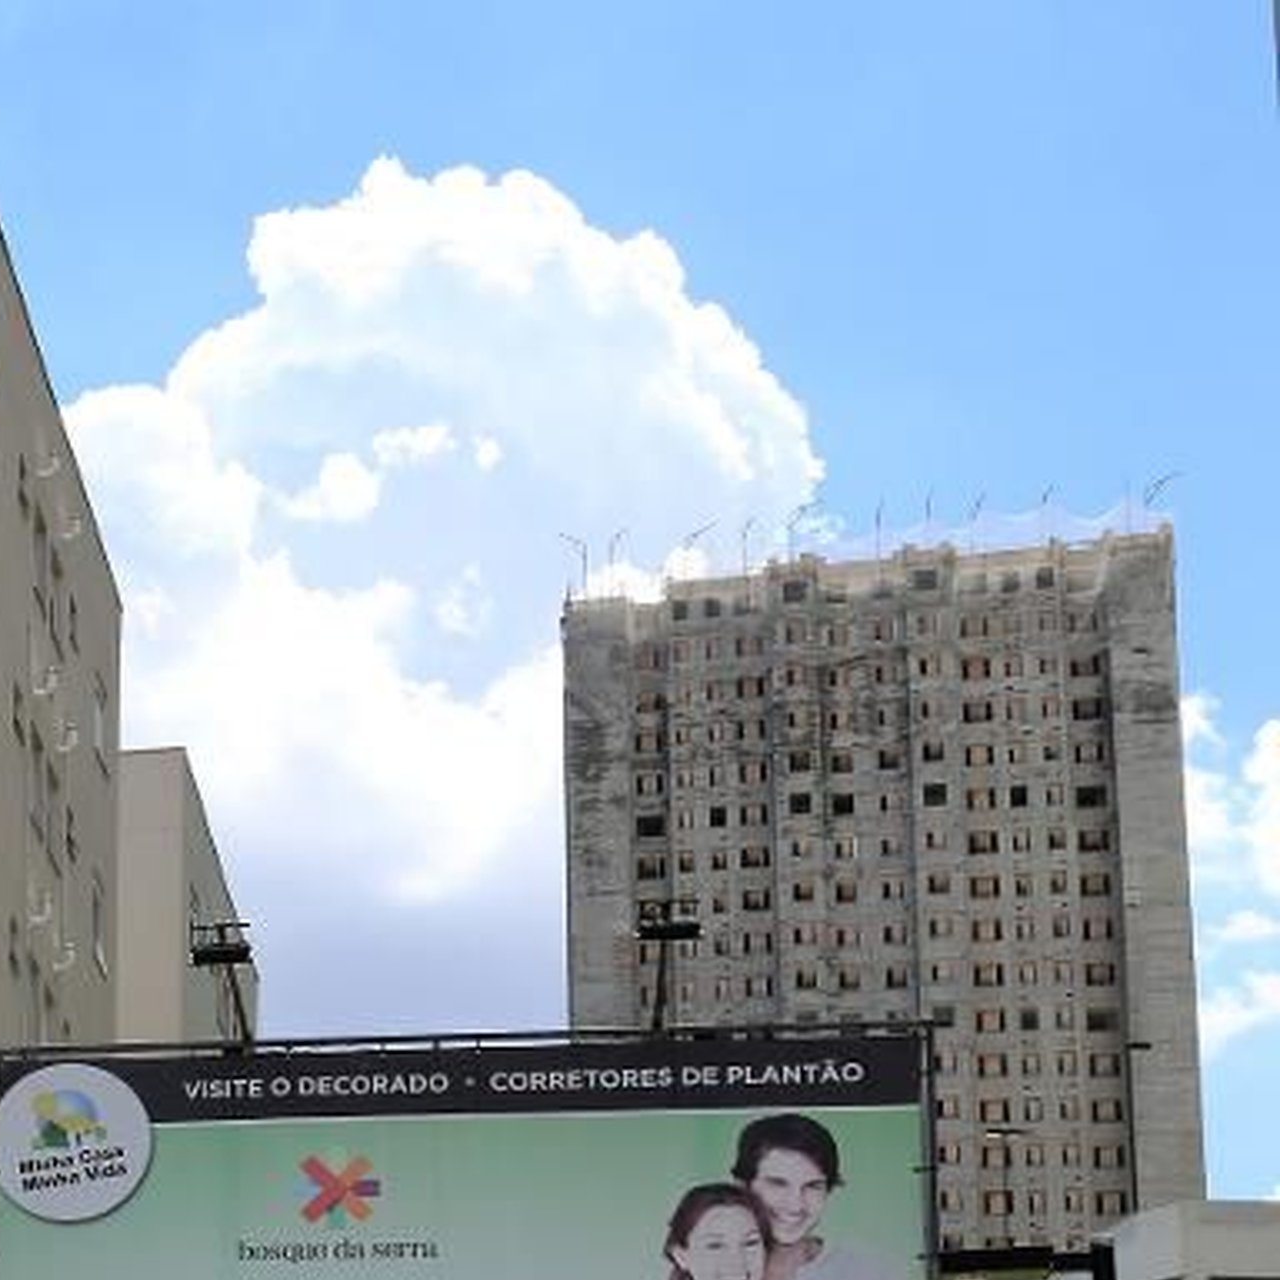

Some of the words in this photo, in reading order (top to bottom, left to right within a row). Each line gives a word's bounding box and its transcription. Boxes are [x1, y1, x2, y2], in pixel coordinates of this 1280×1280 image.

[184, 1078, 264, 1100] VISITE
[270, 1076, 291, 1096] O
[298, 1074, 449, 1097] DECORADO
[489, 1066, 674, 1092] CORRETORES
[681, 1066, 720, 1087] DE
[726, 1058, 865, 1086] PLANTÃO
[21, 1172, 81, 1192] Minha
[83, 1163, 128, 1181] Vida
[237, 1238, 329, 1264] bosque
[332, 1238, 366, 1260] da
[370, 1241, 439, 1260] serra
